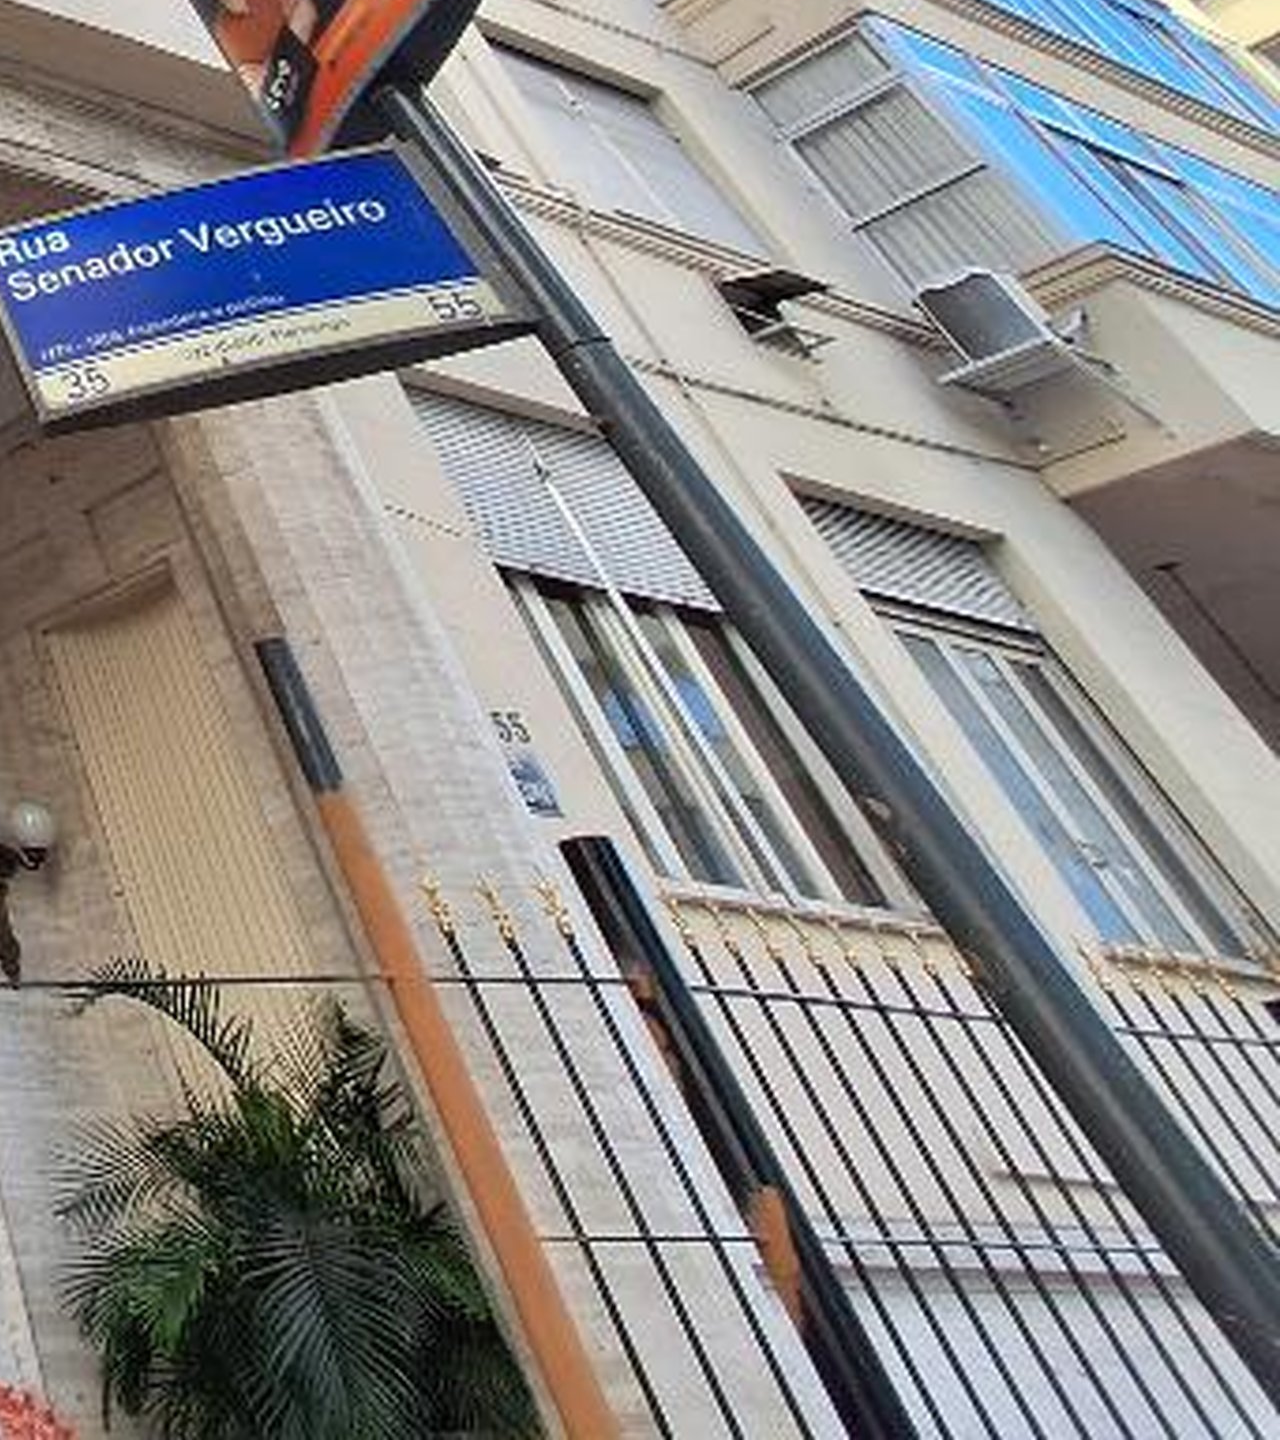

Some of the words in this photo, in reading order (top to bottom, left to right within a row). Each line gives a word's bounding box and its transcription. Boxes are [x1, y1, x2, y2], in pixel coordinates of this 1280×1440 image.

[7, 240, 174, 302] Senador
[177, 197, 386, 253] Vergueiro
[427, 292, 482, 321] 55
[61, 367, 111, 398] 35
[490, 711, 531, 743] 55
